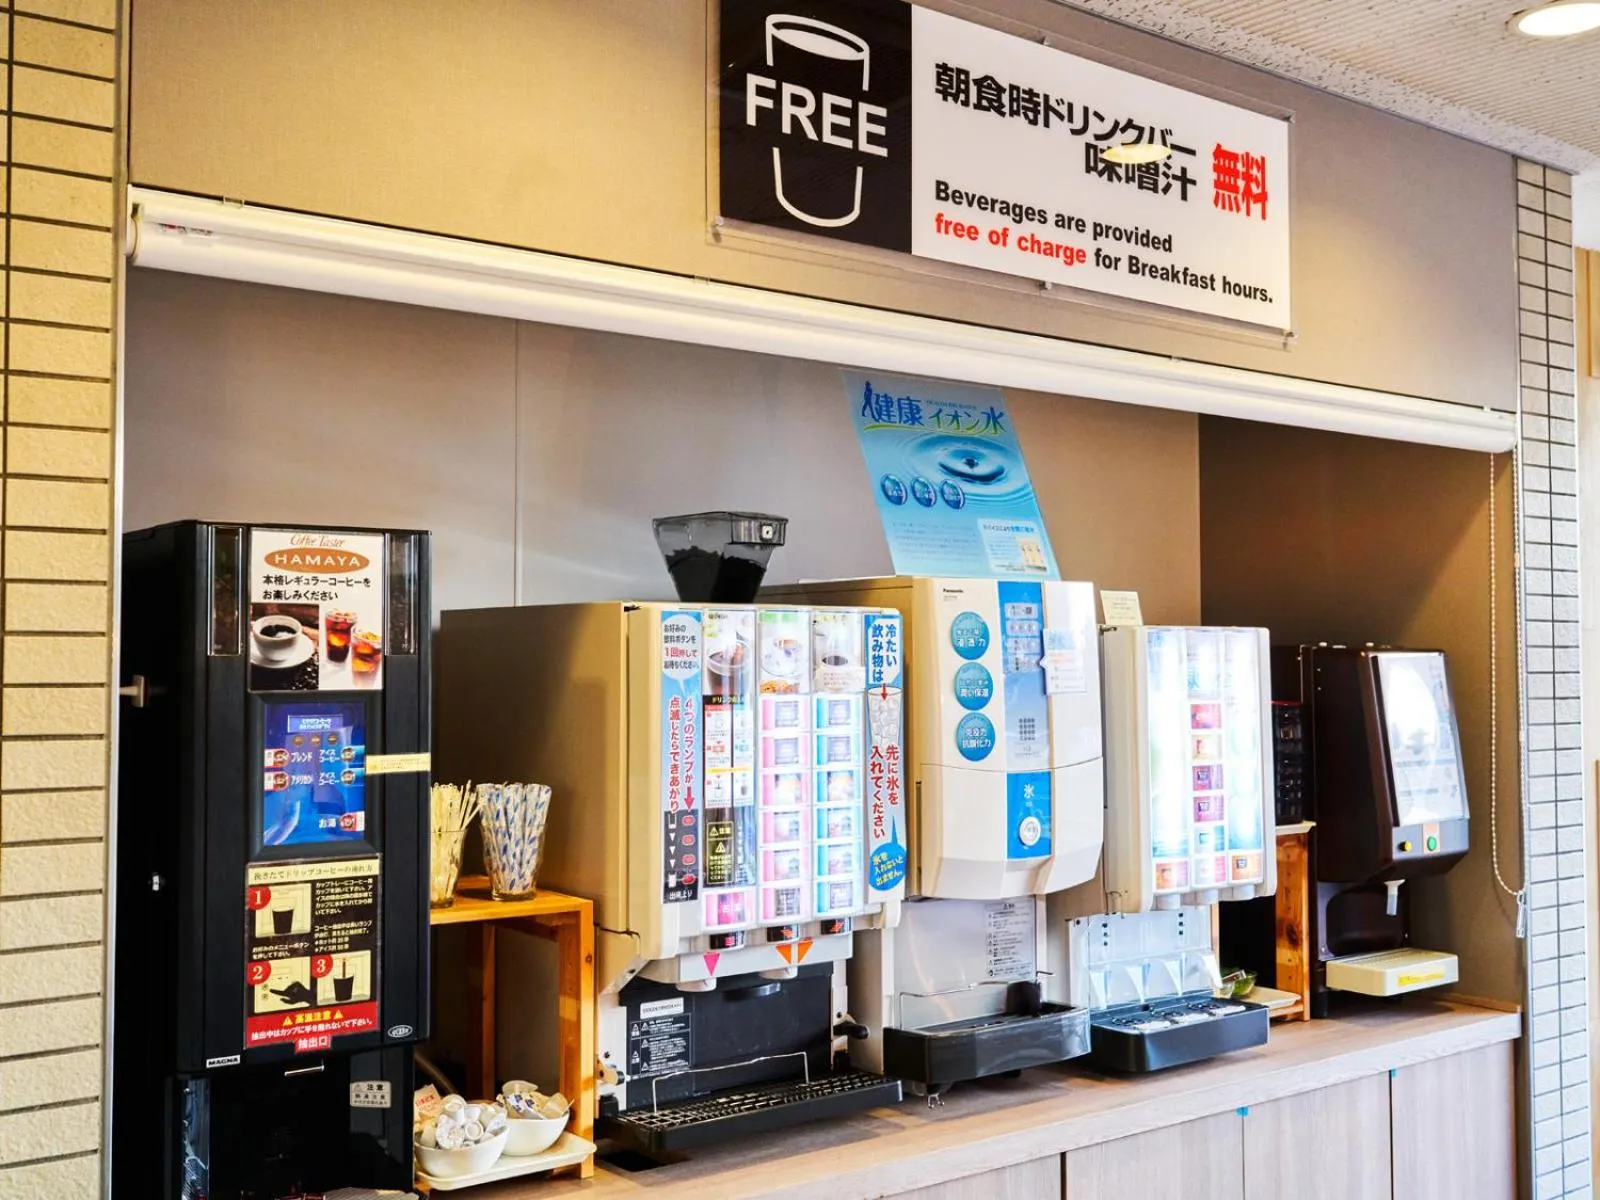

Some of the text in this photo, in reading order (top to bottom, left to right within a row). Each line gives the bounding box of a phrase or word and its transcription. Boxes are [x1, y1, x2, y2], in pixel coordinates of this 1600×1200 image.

[746, 72, 889, 159] FREE
[934, 62, 1197, 158] 朝食時ドリンクバー
[1085, 141, 1198, 202] 味噌汁
[1212, 142, 1268, 221] 無料
[935, 179, 1173, 254] Beverages are provided
[935, 212, 1273, 304] free of charge for Breakfast hours.
[862, 381, 1008, 435] 健康 イオン水
[262, 574, 371, 587] 本格レギュラーコーヒーを
[274, 554, 362, 567] HAMAYA
[262, 590, 338, 601] お楽しみください
[663, 624, 687, 633] お好みの
[872, 623, 884, 682] 飲み物は
[886, 623, 897, 667] 冷たい
[669, 697, 681, 813] 点滅したらできあがり
[886, 745, 899, 806] 先に氷を
[870, 745, 885, 839] 入れてください
[1024, 783, 1035, 800] 氷
[255, 890, 262, 906] 1
[253, 966, 263, 980] 2
[316, 959, 327, 973] 3
[298, 1037, 328, 1049] 抽出口
